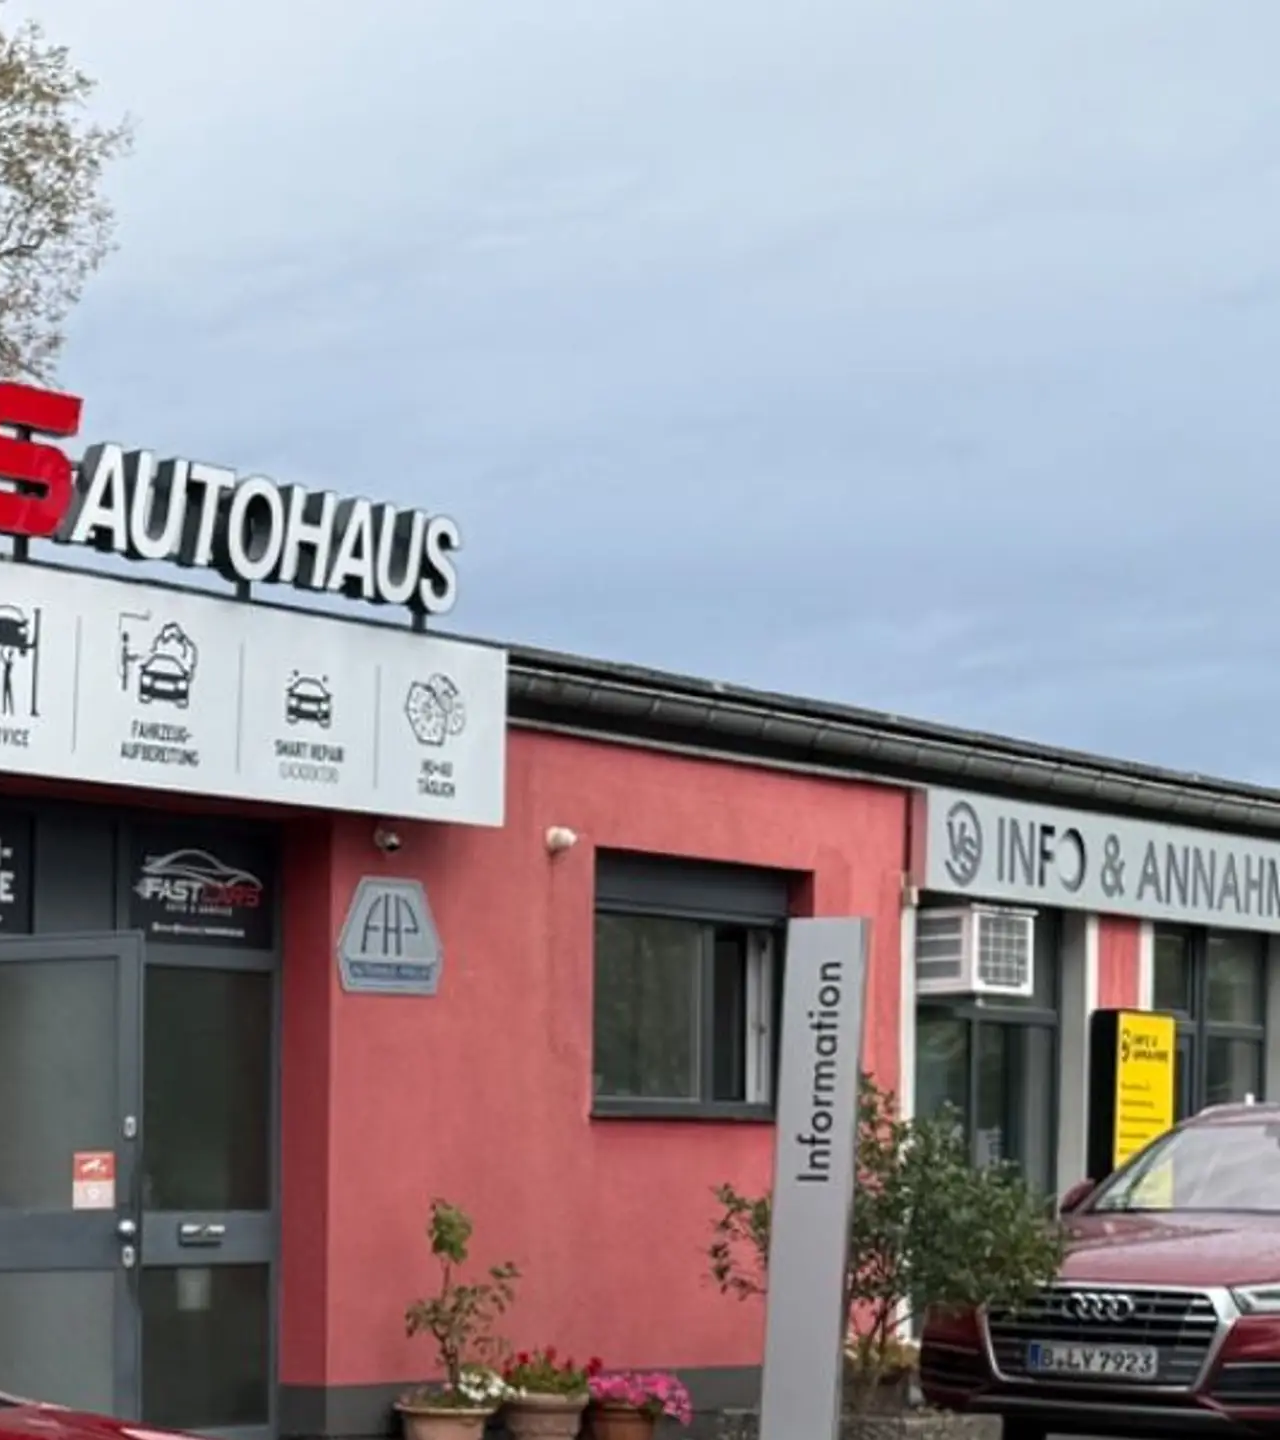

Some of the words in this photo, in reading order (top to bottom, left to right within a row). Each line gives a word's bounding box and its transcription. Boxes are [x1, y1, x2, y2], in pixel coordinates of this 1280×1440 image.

[68, 442, 463, 614] AUTOHAUS
[1100, 832, 1126, 899] &
[796, 959, 844, 1184] Information
